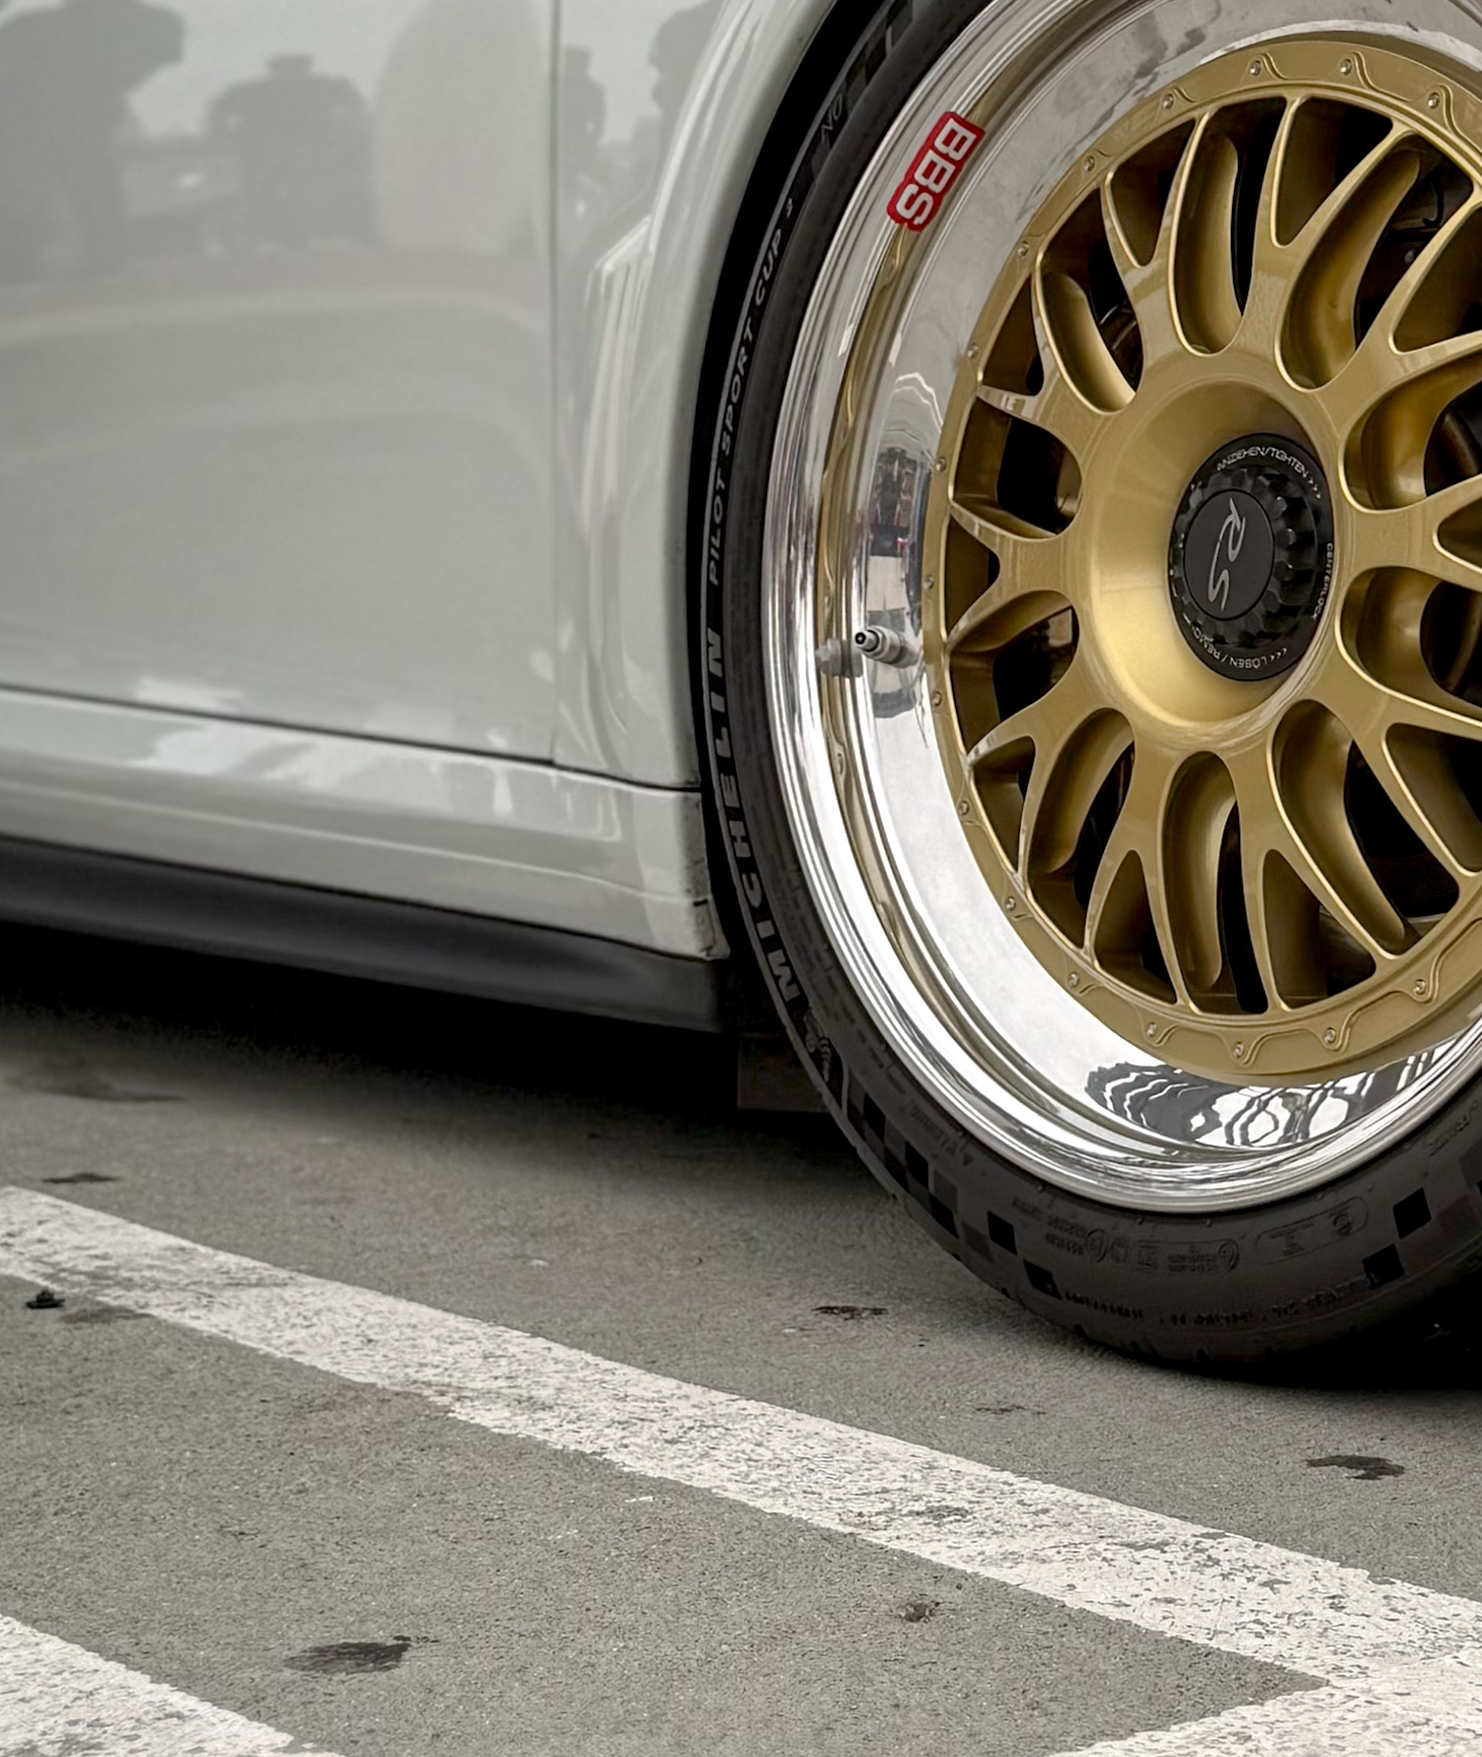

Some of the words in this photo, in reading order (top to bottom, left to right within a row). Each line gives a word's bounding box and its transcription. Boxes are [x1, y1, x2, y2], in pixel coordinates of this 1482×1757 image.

[895, 117, 977, 226] BBS
[709, 467, 726, 585] PILOT
[720, 316, 754, 456] SPORT
[755, 228, 782, 306] CUP
[706, 626, 799, 1002] MICHELIN
